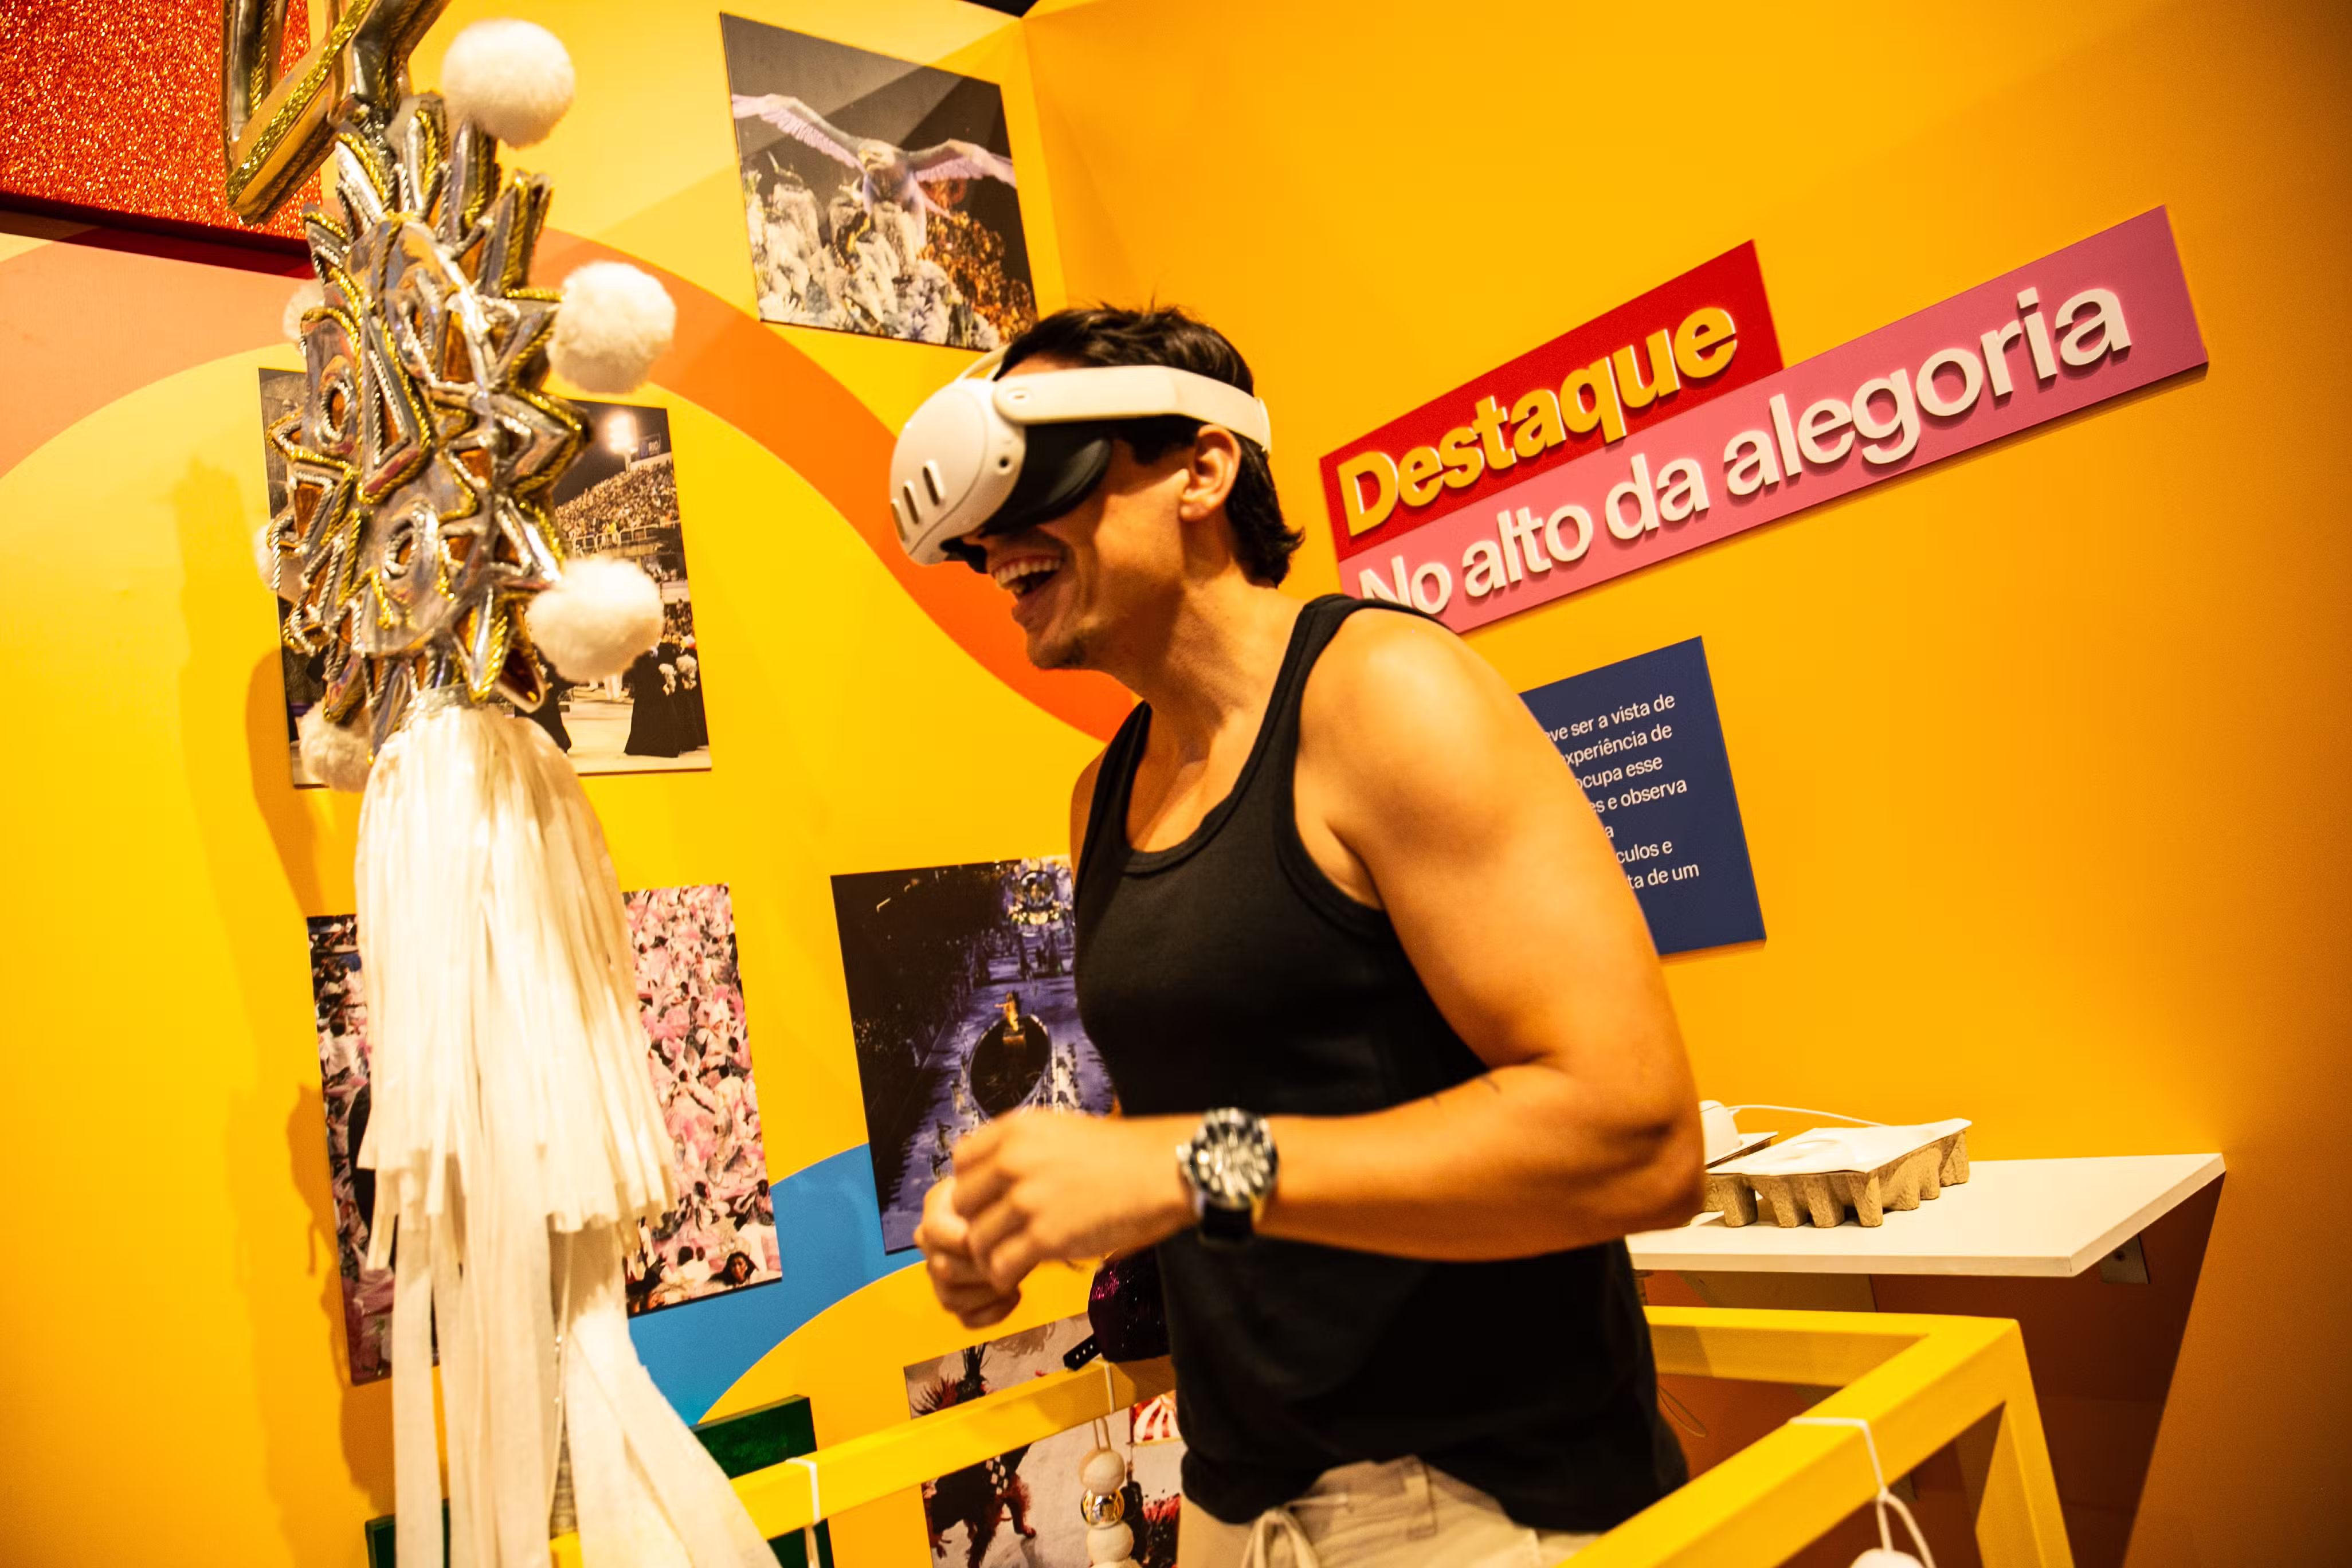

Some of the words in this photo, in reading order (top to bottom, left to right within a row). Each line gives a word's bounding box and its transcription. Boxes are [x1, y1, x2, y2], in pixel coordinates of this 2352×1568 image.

[1338, 305, 1738, 536] Destaque
[1359, 555, 1452, 614] No
[1463, 509, 1593, 598] alto
[1605, 454, 1710, 541] da
[1723, 287, 2133, 497] alegoria
[1571, 718, 1594, 736] ser
[1598, 715, 1608, 728] a
[1611, 703, 1651, 724] vista
[1653, 693, 1675, 712] de
[1562, 731, 1648, 767] xperiência
[1651, 723, 1672, 742] de
[1626, 756, 1663, 777] esse
[1608, 797, 1618, 810] e
[1621, 779, 1687, 807] observa
[1662, 840, 1673, 854] e
[1648, 868, 1669, 885] de
[1672, 864, 1699, 881] um
